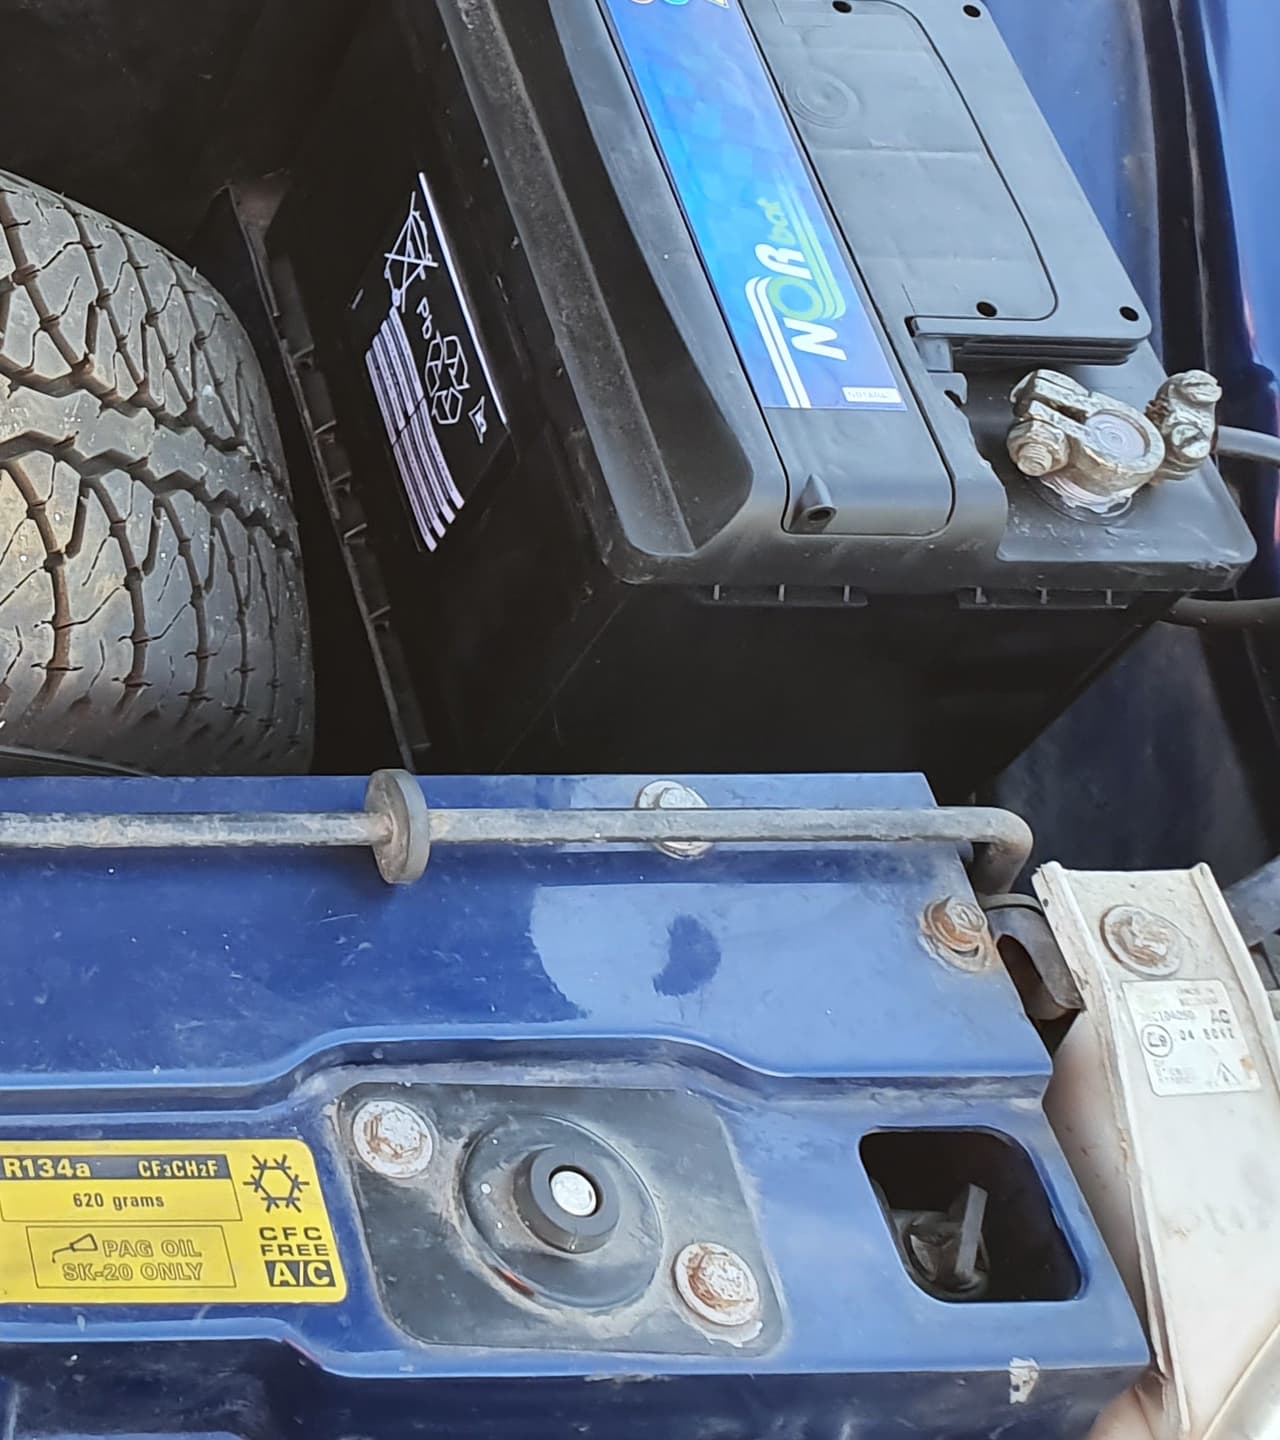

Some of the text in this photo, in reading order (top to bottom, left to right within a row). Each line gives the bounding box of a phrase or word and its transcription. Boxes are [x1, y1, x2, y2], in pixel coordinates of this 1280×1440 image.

[3, 1158, 92, 1178] R134a
[72, 1192, 165, 1211] 620 grams
[259, 1226, 323, 1241] CFC
[102, 1239, 202, 1257] PAG OIL
[260, 1243, 330, 1257] FREE
[61, 1262, 203, 1281] SK-20 ONLY
[271, 1260, 332, 1286] A/C
